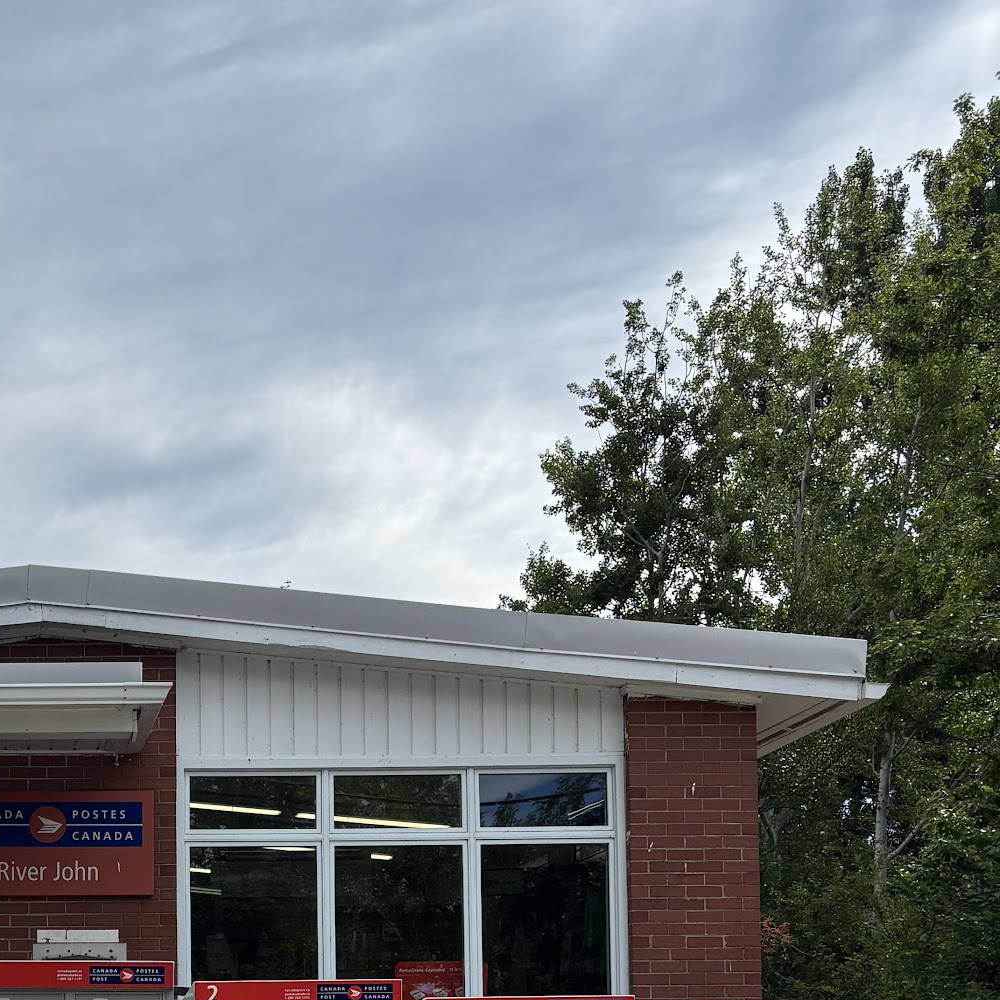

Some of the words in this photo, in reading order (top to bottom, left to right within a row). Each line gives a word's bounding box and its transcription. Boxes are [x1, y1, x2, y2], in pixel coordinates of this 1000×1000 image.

[72, 810, 126, 819] POSTES
[72, 831, 134, 841] CANADA
[53, 860, 99, 881] John
